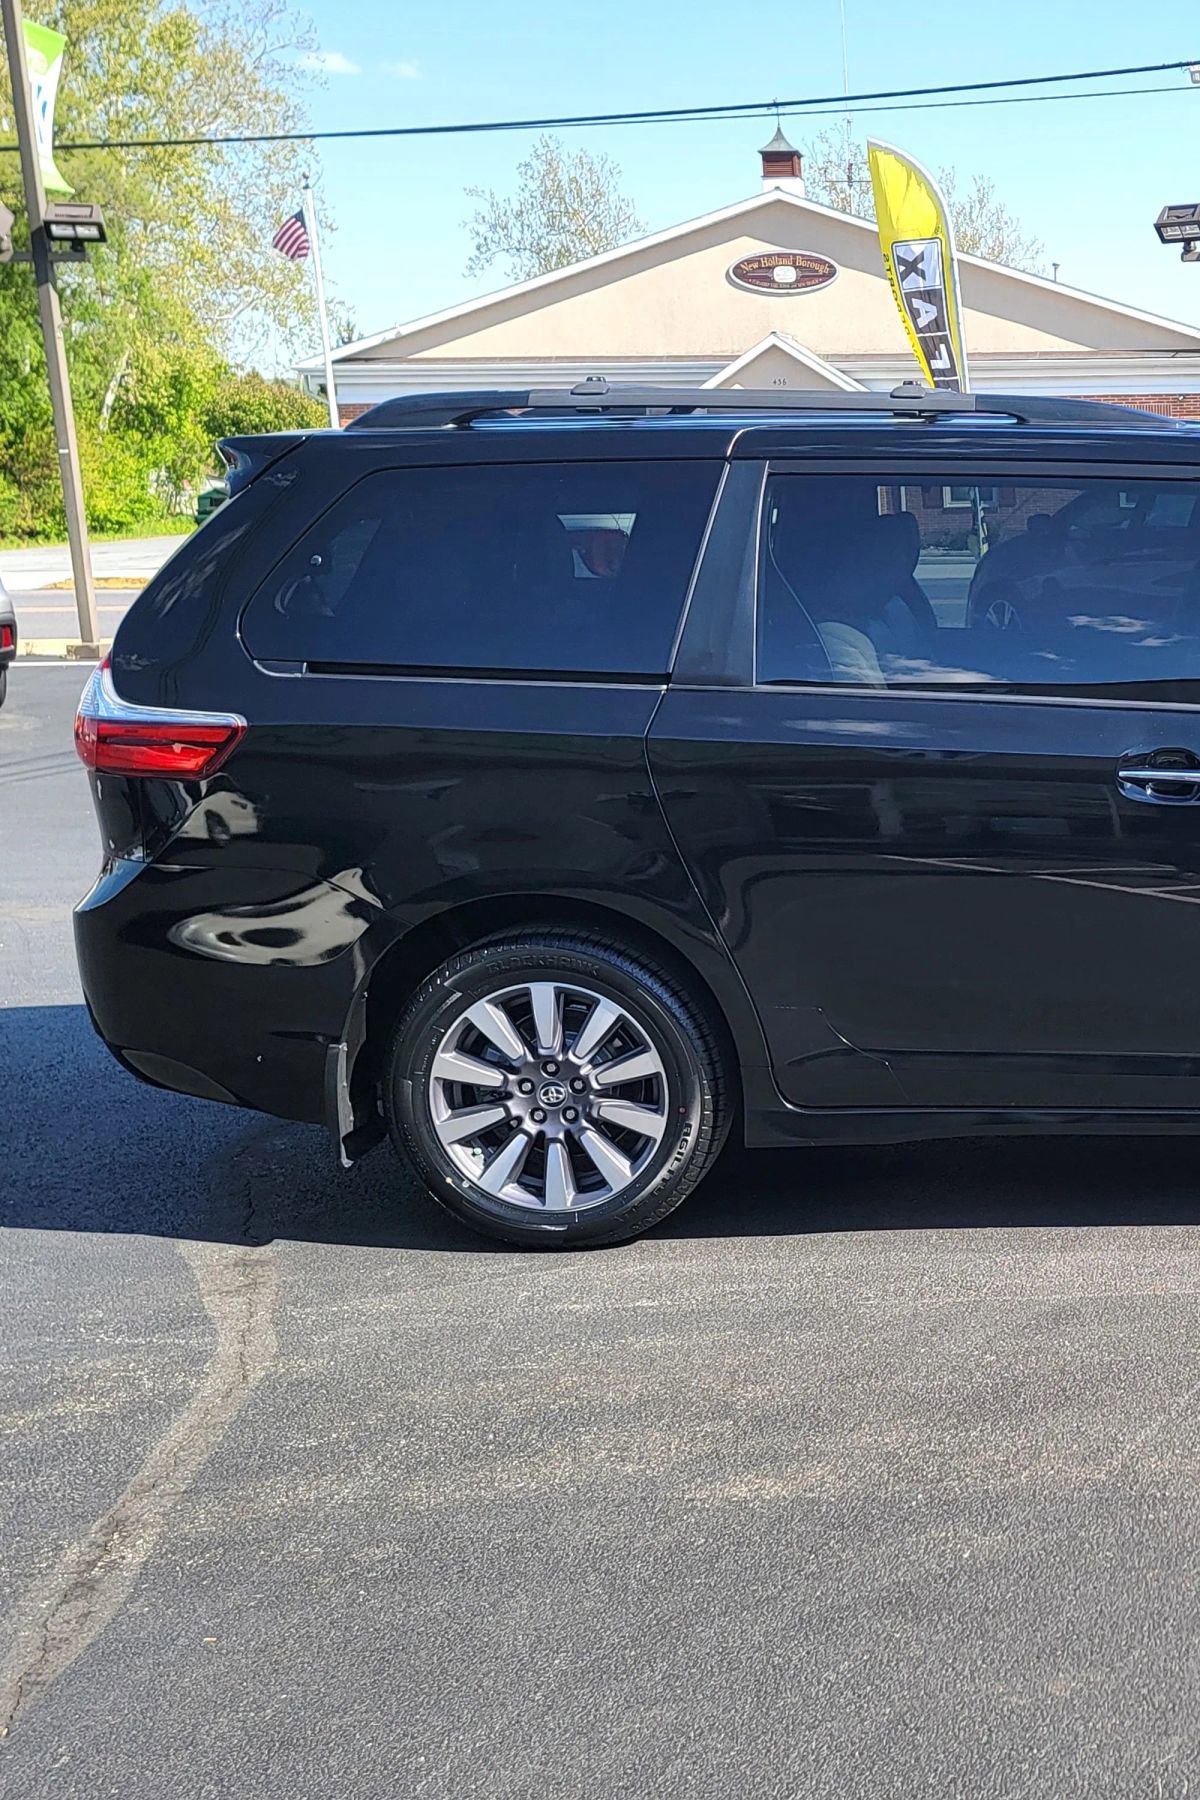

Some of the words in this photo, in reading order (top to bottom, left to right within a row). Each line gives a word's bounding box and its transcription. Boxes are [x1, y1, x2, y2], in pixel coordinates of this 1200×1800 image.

[740, 262, 759, 272] New
[760, 255, 793, 268] Holland
[796, 255, 830, 274] Borough
